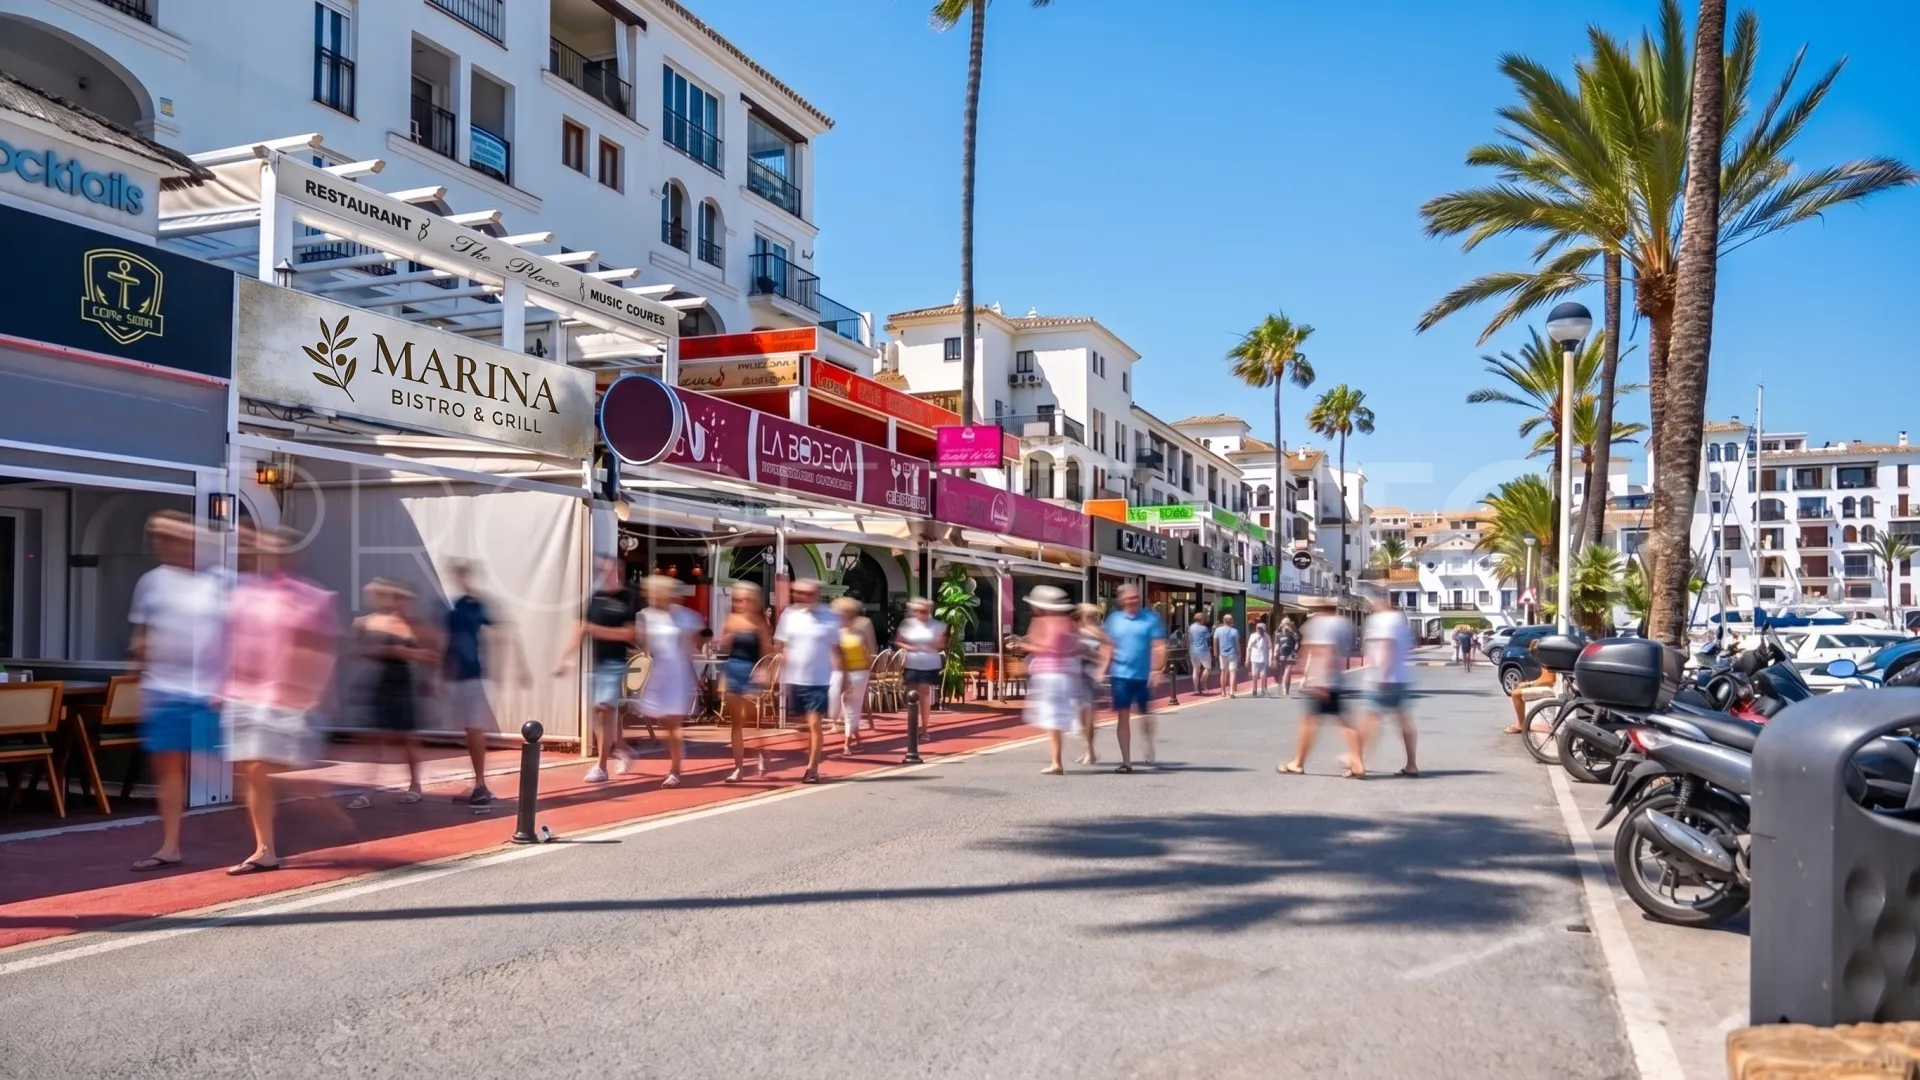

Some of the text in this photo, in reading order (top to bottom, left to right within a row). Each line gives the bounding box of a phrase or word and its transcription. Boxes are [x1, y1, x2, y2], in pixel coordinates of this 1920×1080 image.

[305, 179, 666, 326] RESTAURANT The Place MUSIC COURES
[371, 332, 560, 415] MARINA
[391, 388, 542, 434] BISTRO & GRILL
[761, 424, 784, 459] LA
